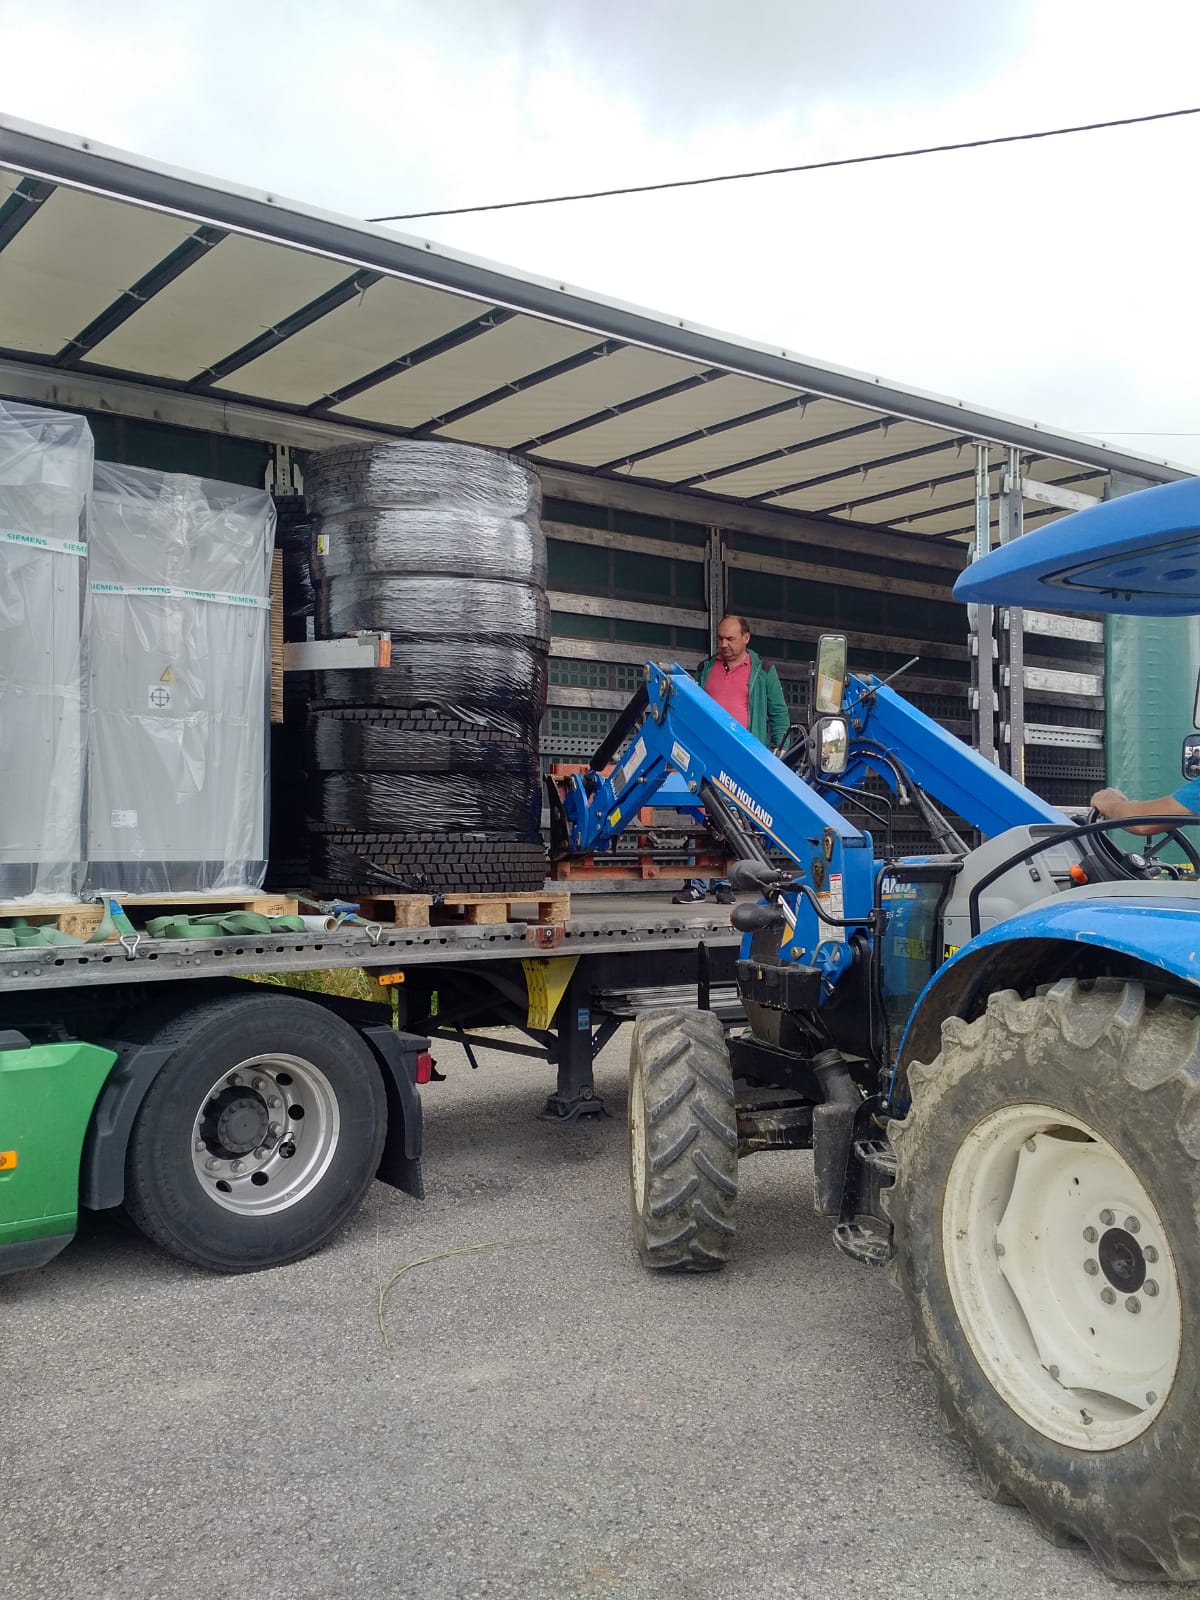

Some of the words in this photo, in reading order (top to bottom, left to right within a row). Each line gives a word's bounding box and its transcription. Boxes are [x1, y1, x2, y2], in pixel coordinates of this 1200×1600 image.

[7, 533, 48, 546] SIEMENS
[227, 595, 258, 605] SIEMENS
[718, 770, 738, 794] NEW
[736, 786, 773, 828] HOLLAND
